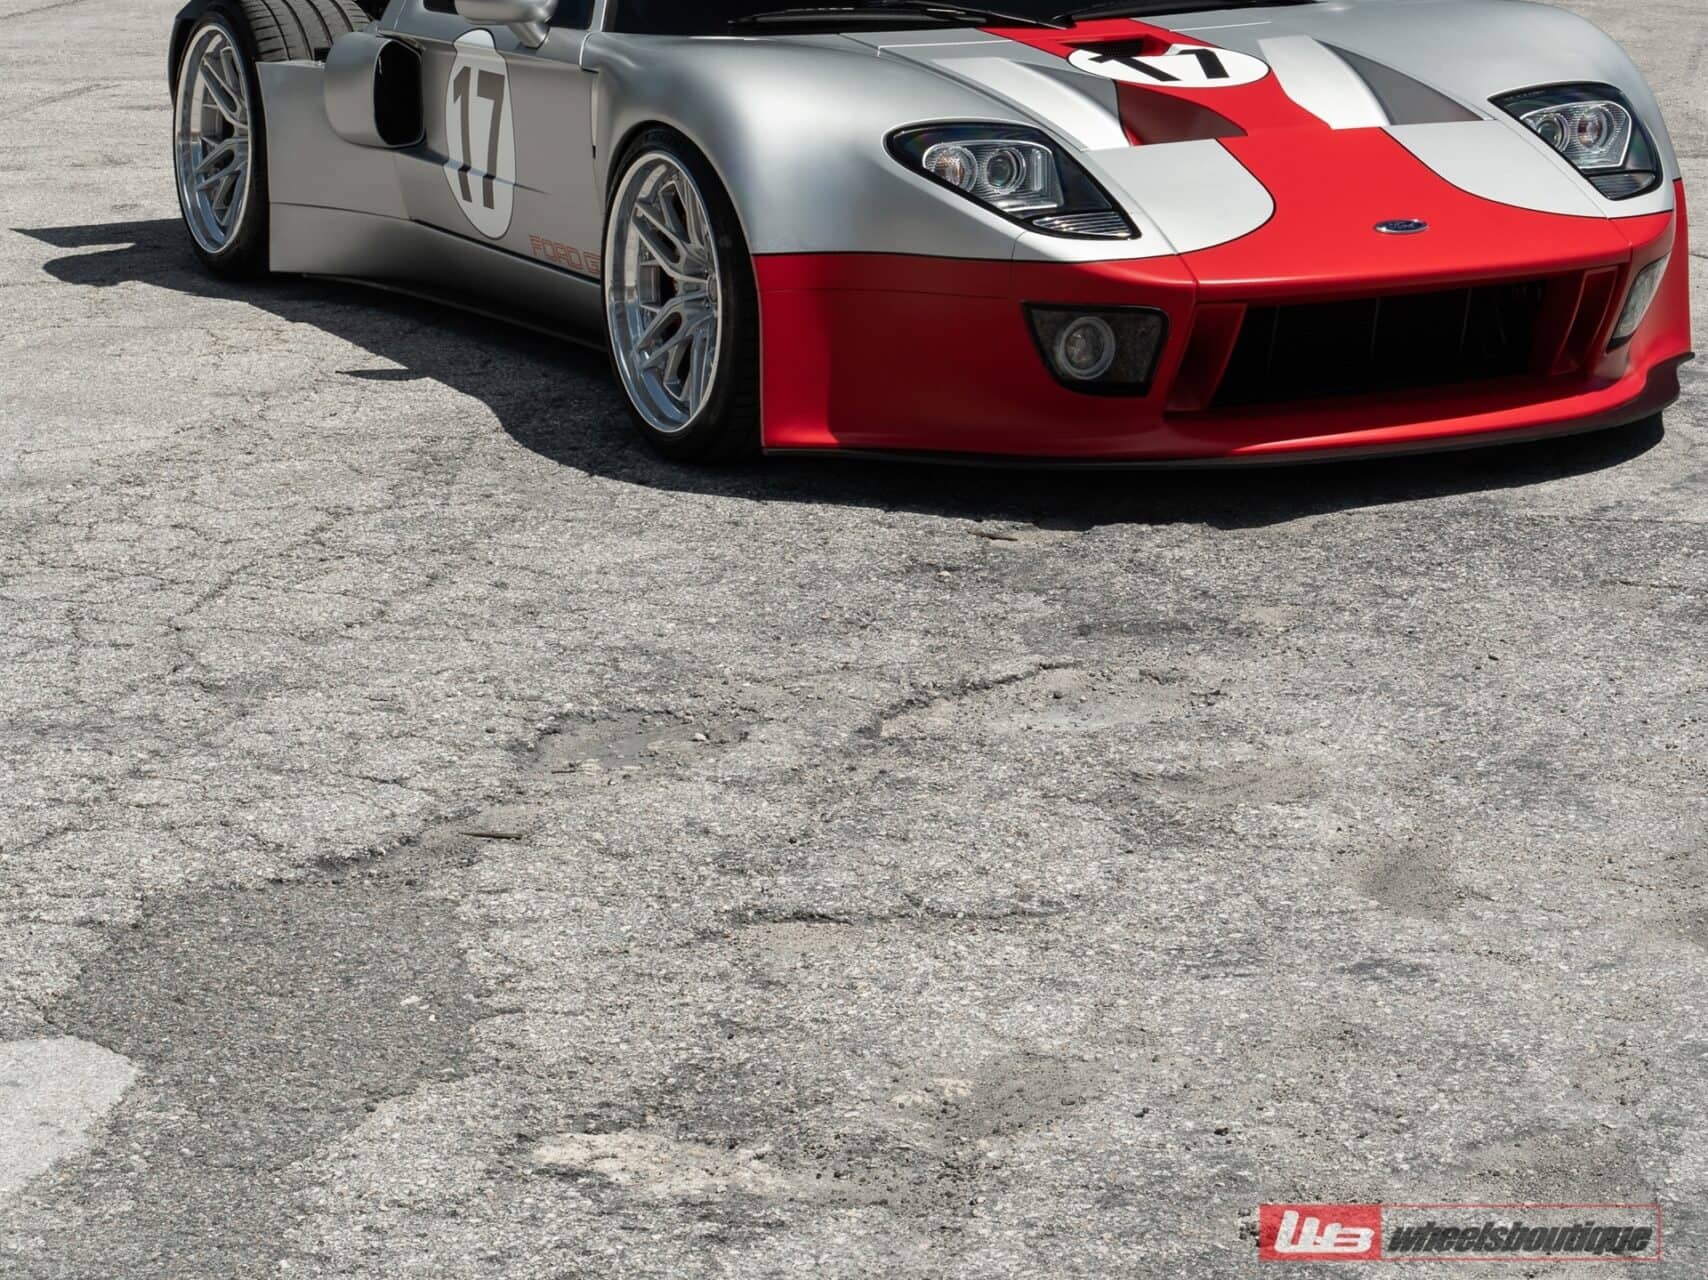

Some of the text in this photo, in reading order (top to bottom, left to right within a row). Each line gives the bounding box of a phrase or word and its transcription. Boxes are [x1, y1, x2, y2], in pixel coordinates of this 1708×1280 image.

[453, 66, 505, 209] 17
[528, 233, 601, 276] FORD G
